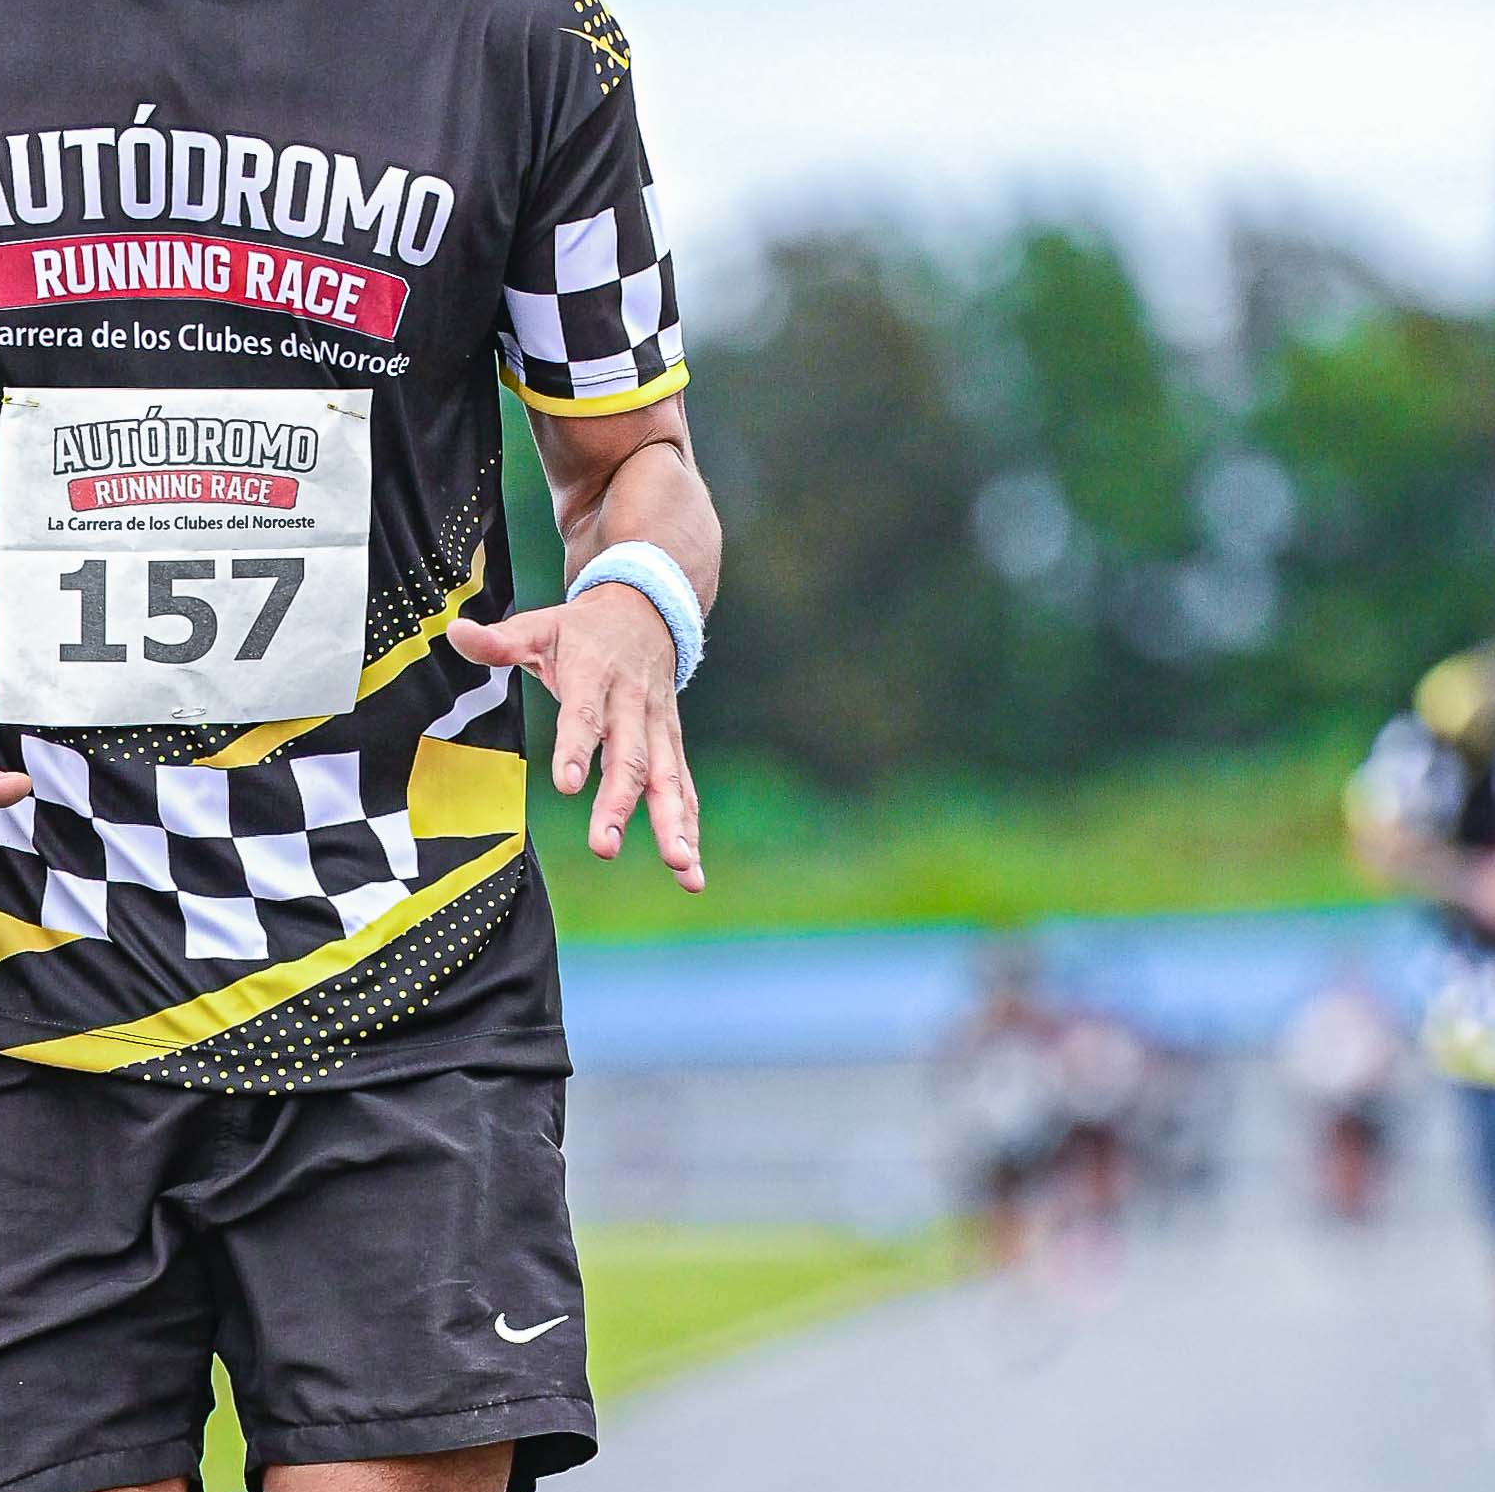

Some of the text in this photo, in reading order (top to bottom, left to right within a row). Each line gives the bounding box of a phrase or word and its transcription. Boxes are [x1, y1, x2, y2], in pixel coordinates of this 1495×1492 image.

[32, 240, 367, 325] RUNNING RACE
[90, 320, 127, 350] de
[133, 321, 171, 352] los
[177, 323, 273, 357] Clubes
[53, 405, 319, 475] AUTÓDROMO
[94, 474, 273, 506] RUNNING RACE
[47, 515, 316, 531] La Carrera de los Clubes del Noroeste
[59, 557, 306, 665] 157
